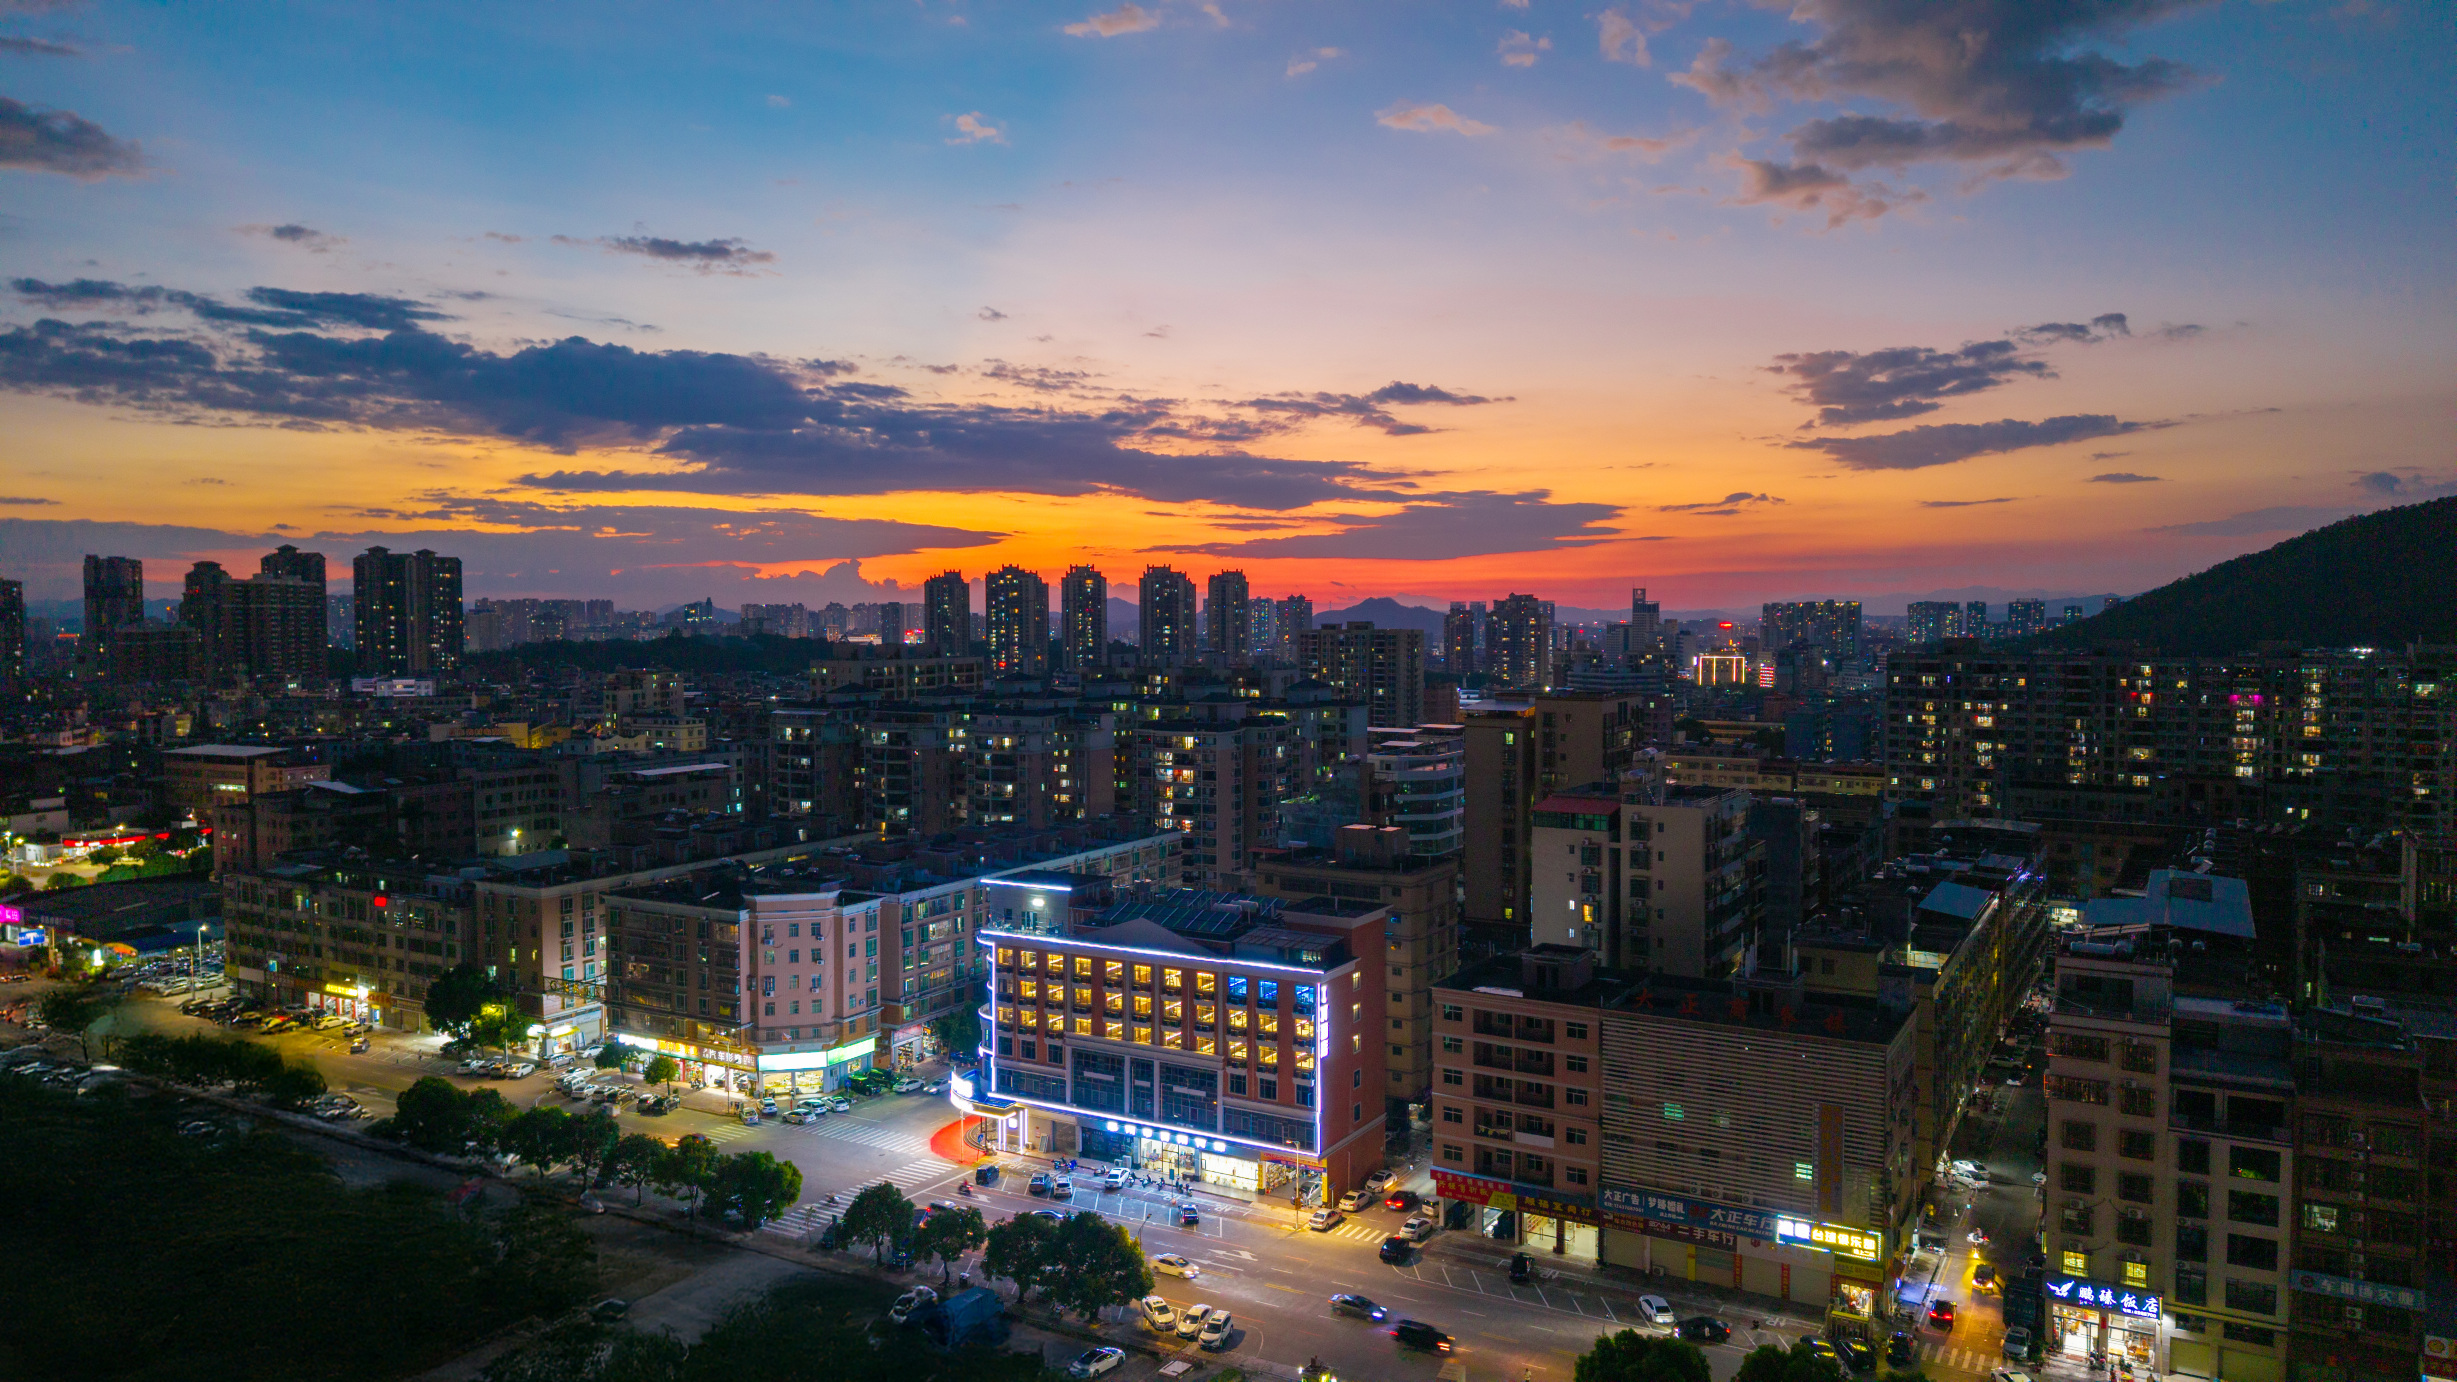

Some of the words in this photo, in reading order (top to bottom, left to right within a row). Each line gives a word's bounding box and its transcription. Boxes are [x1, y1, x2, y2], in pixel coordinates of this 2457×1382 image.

[1604, 1189, 1640, 1206] 大正广告
[1710, 1208, 1777, 1230] 大正车行
[1677, 1225, 1735, 1246] 二手车行
